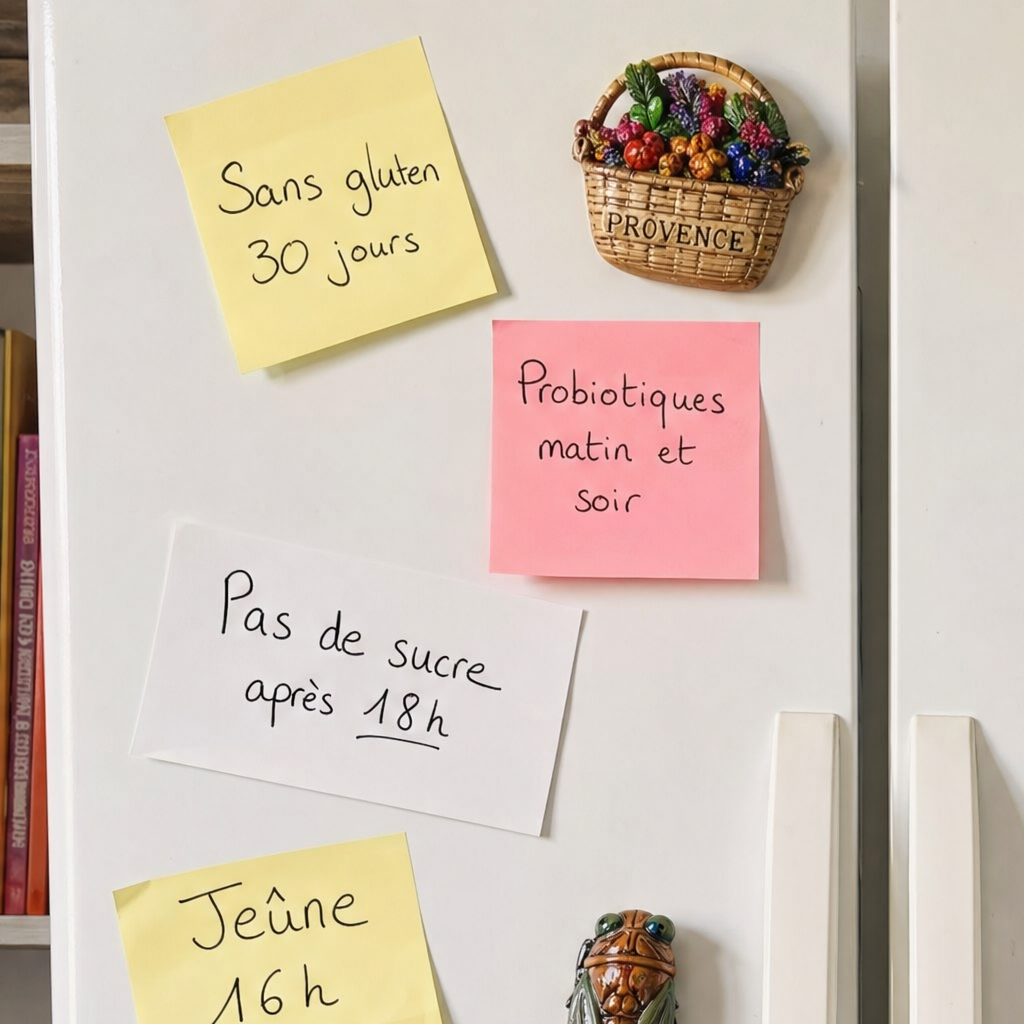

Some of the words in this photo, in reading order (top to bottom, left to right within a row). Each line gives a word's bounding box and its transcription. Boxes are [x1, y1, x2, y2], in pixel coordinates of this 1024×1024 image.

[218, 160, 323, 215] Sans
[345, 142, 440, 217] gluten
[247, 239, 309, 285] 30
[327, 232, 420, 288] jours
[604, 208, 746, 256] PROVENCE
[517, 358, 725, 430] Probiotiques
[538, 430, 633, 462] matin
[657, 434, 697, 466] et
[574, 488, 642, 513] soir
[221, 569, 292, 641] Pas
[319, 609, 365, 657] de
[387, 639, 502, 691] sucre
[244, 678, 334, 728] après
[362, 688, 449, 738] 18h
[177, 881, 369, 951] Jeûne
